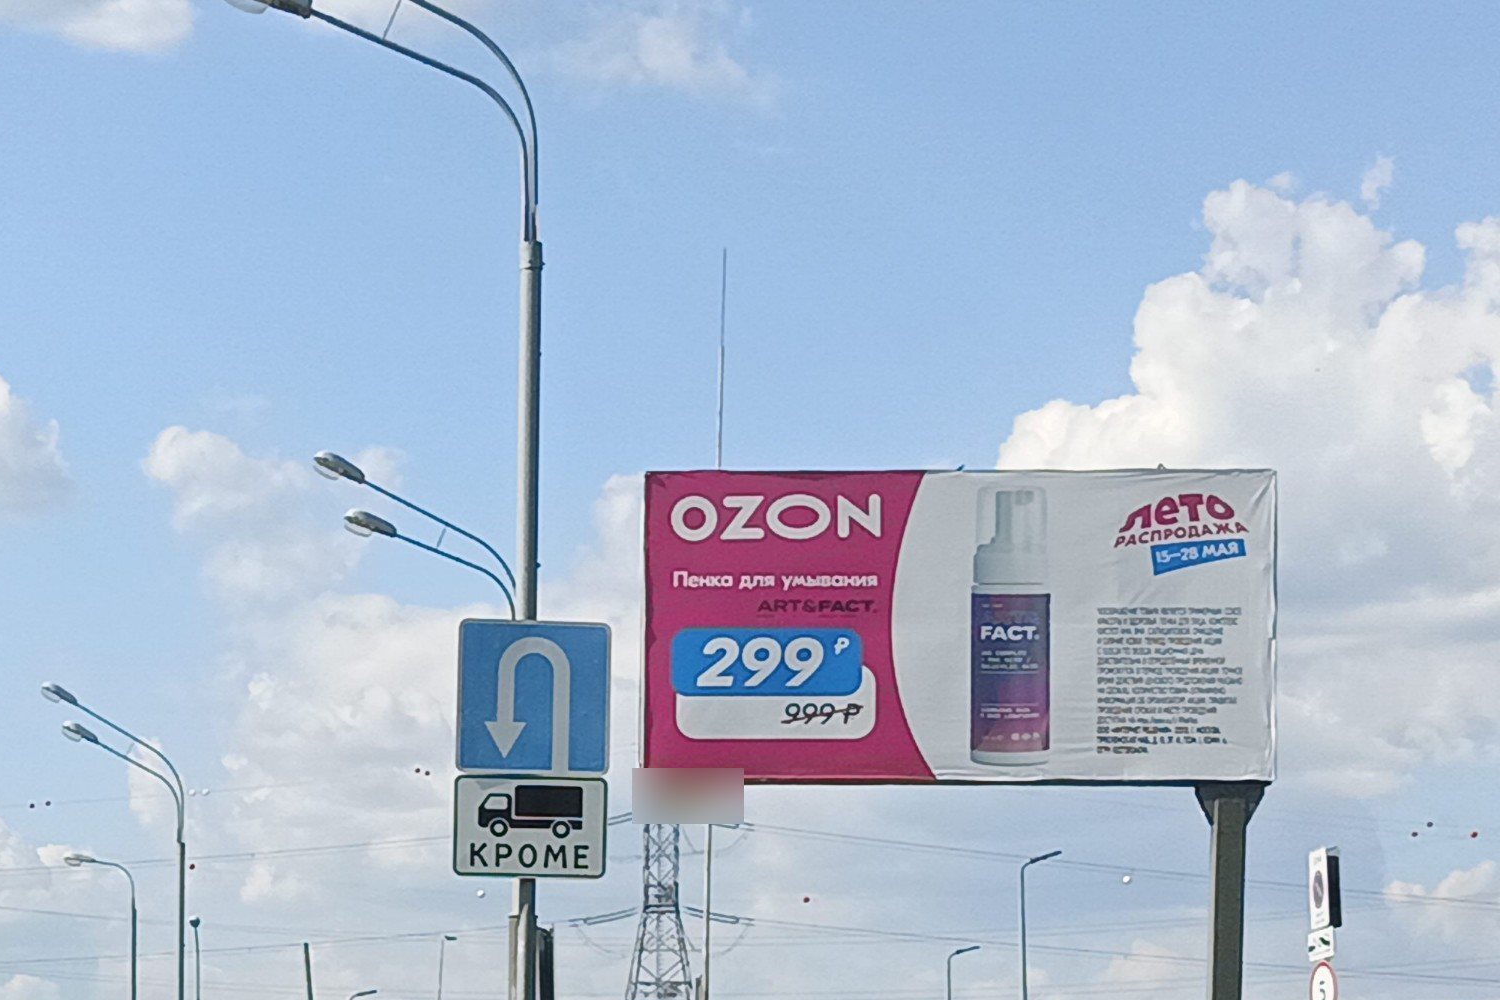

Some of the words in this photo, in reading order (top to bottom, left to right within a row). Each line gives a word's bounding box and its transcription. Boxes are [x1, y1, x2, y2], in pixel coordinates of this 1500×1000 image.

[671, 494, 882, 541] OZON
[1113, 521, 1249, 548] РАСПРОДАЖА
[1202, 541, 1239, 558] МАЯ
[673, 571, 733, 588] Пенка
[739, 575, 775, 590] для
[781, 575, 878, 591] умывания
[696, 637, 824, 687] 299
[470, 843, 589, 869] КРОМЕ
